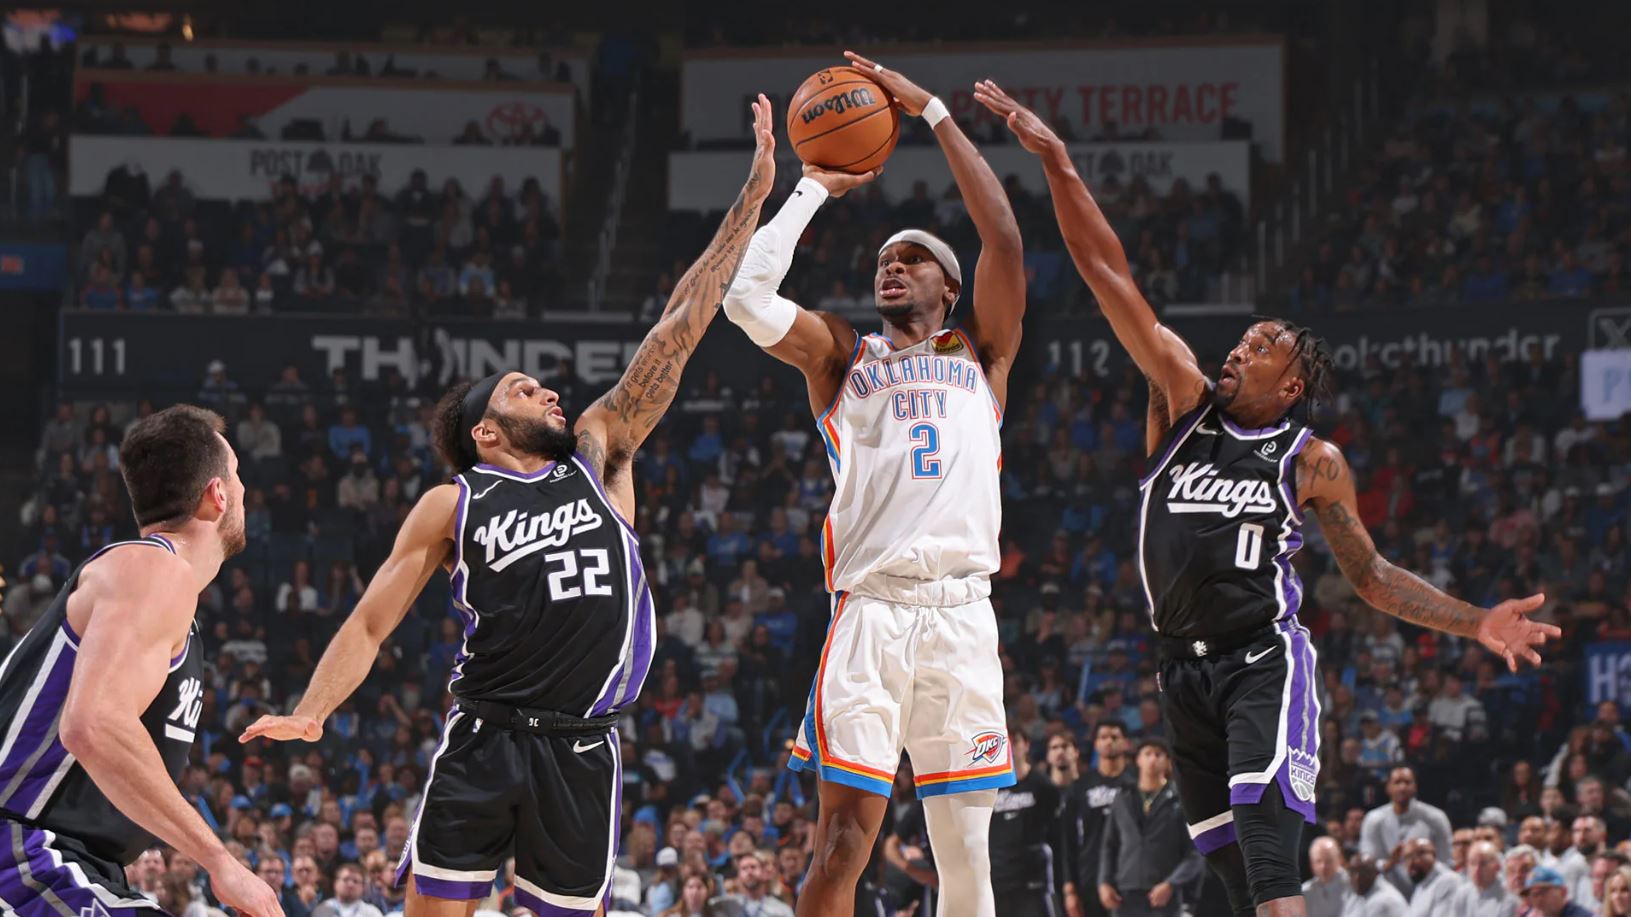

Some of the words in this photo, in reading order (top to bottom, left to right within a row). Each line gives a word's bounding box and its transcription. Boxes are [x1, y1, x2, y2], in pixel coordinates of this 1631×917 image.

[801, 88, 876, 124] Wilson
[951, 86, 1064, 126] PATY
[1077, 82, 1240, 125] TERRACE
[250, 149, 304, 177] POST
[338, 150, 383, 178] OAK
[1130, 151, 1174, 175] OAK
[69, 338, 127, 376] 111
[638, 363, 657, 388] before
[848, 355, 978, 399] OKLAHOMA
[1047, 340, 1111, 379] 112
[644, 382, 659, 400] gets
[655, 359, 674, 383] better
[892, 389, 947, 420] CITY
[909, 421, 942, 479] 2
[1167, 462, 1276, 518] Kings
[473, 498, 602, 572] Kings
[1235, 523, 1264, 571] 0
[544, 549, 612, 602] 22
[1291, 767, 1315, 785] KINGS
